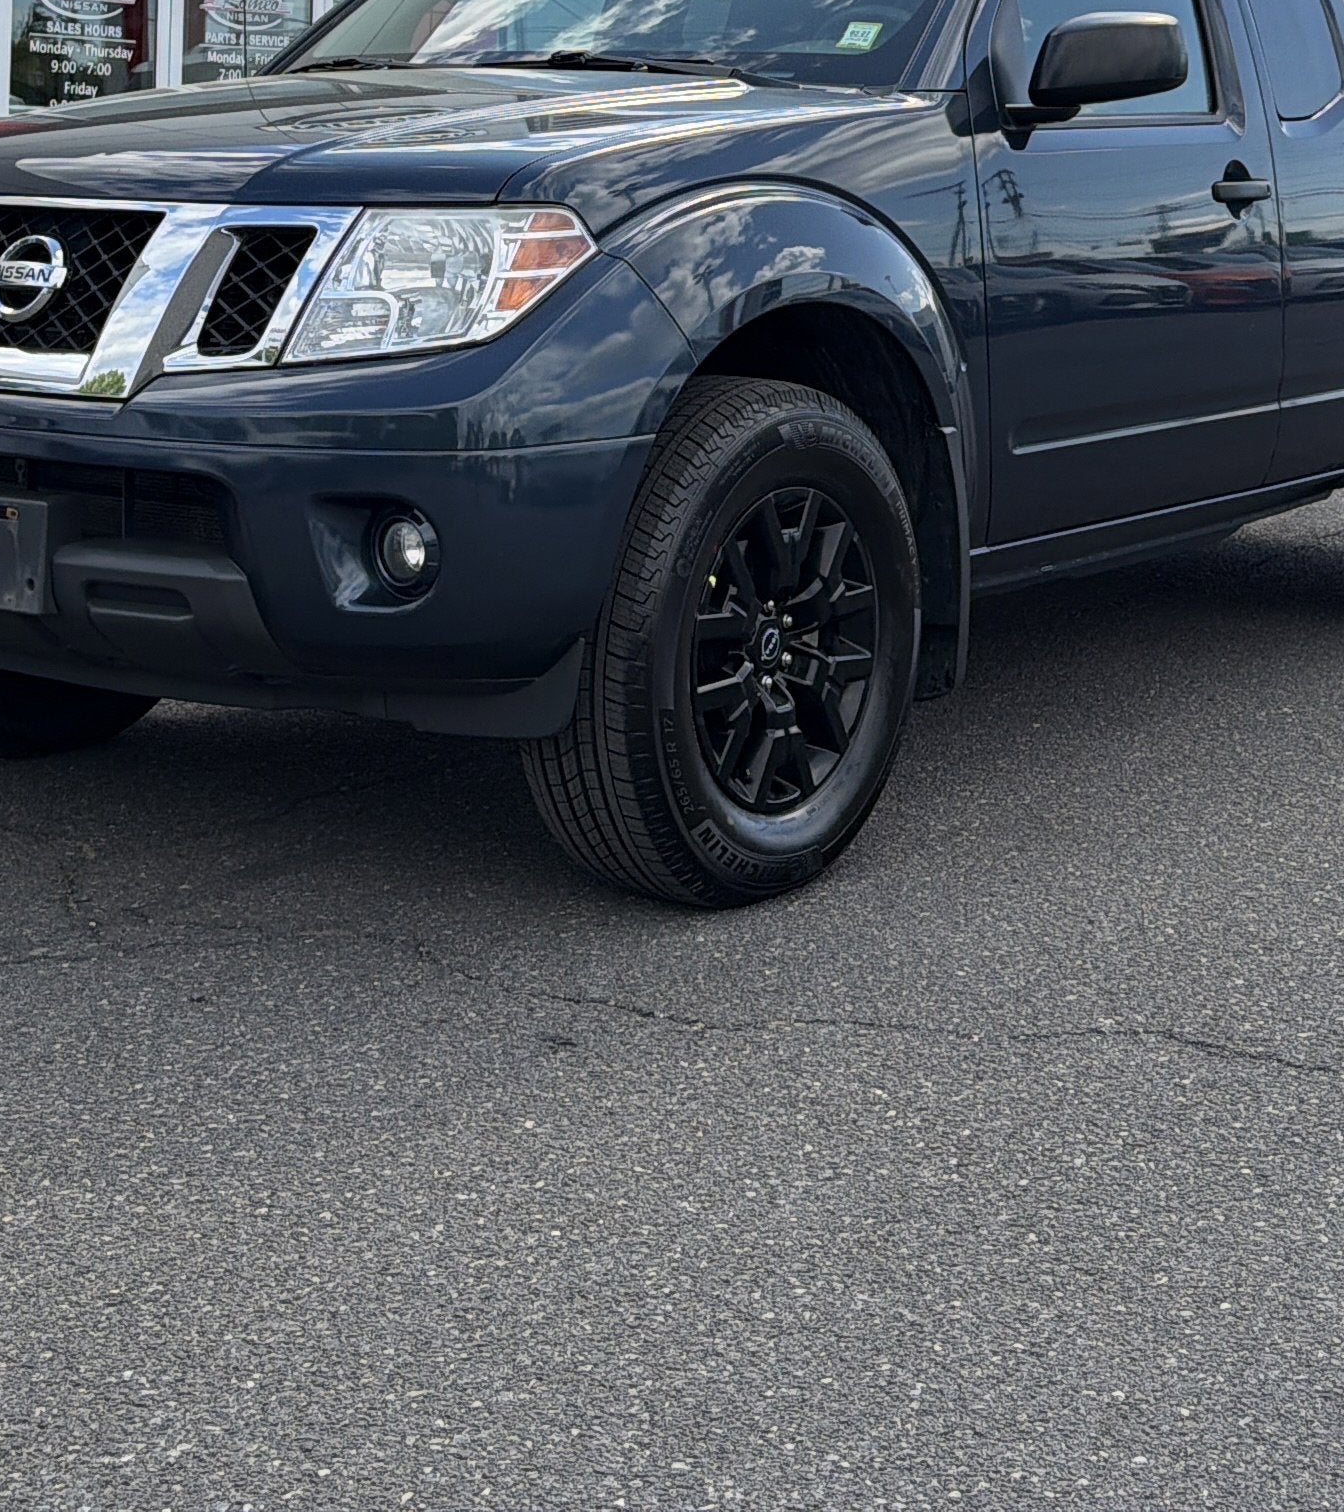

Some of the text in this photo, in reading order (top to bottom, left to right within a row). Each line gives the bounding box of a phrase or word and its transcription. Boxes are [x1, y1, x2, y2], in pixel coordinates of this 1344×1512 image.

[61, 1, 109, 12] NISSAN
[226, 13, 269, 23] NISSAN
[46, 21, 122, 38] SALES HOURS
[205, 32, 236, 45] PARTS
[29, 40, 74, 57] Monday
[84, 44, 134, 62] Thursday
[207, 51, 245, 67] Monday
[51, 60, 76, 74] 9:00
[87, 62, 112, 76] 7:00
[64, 81, 99, 98] Friday
[665, 742, 678, 753] R
[667, 759, 696, 816] 265/65
